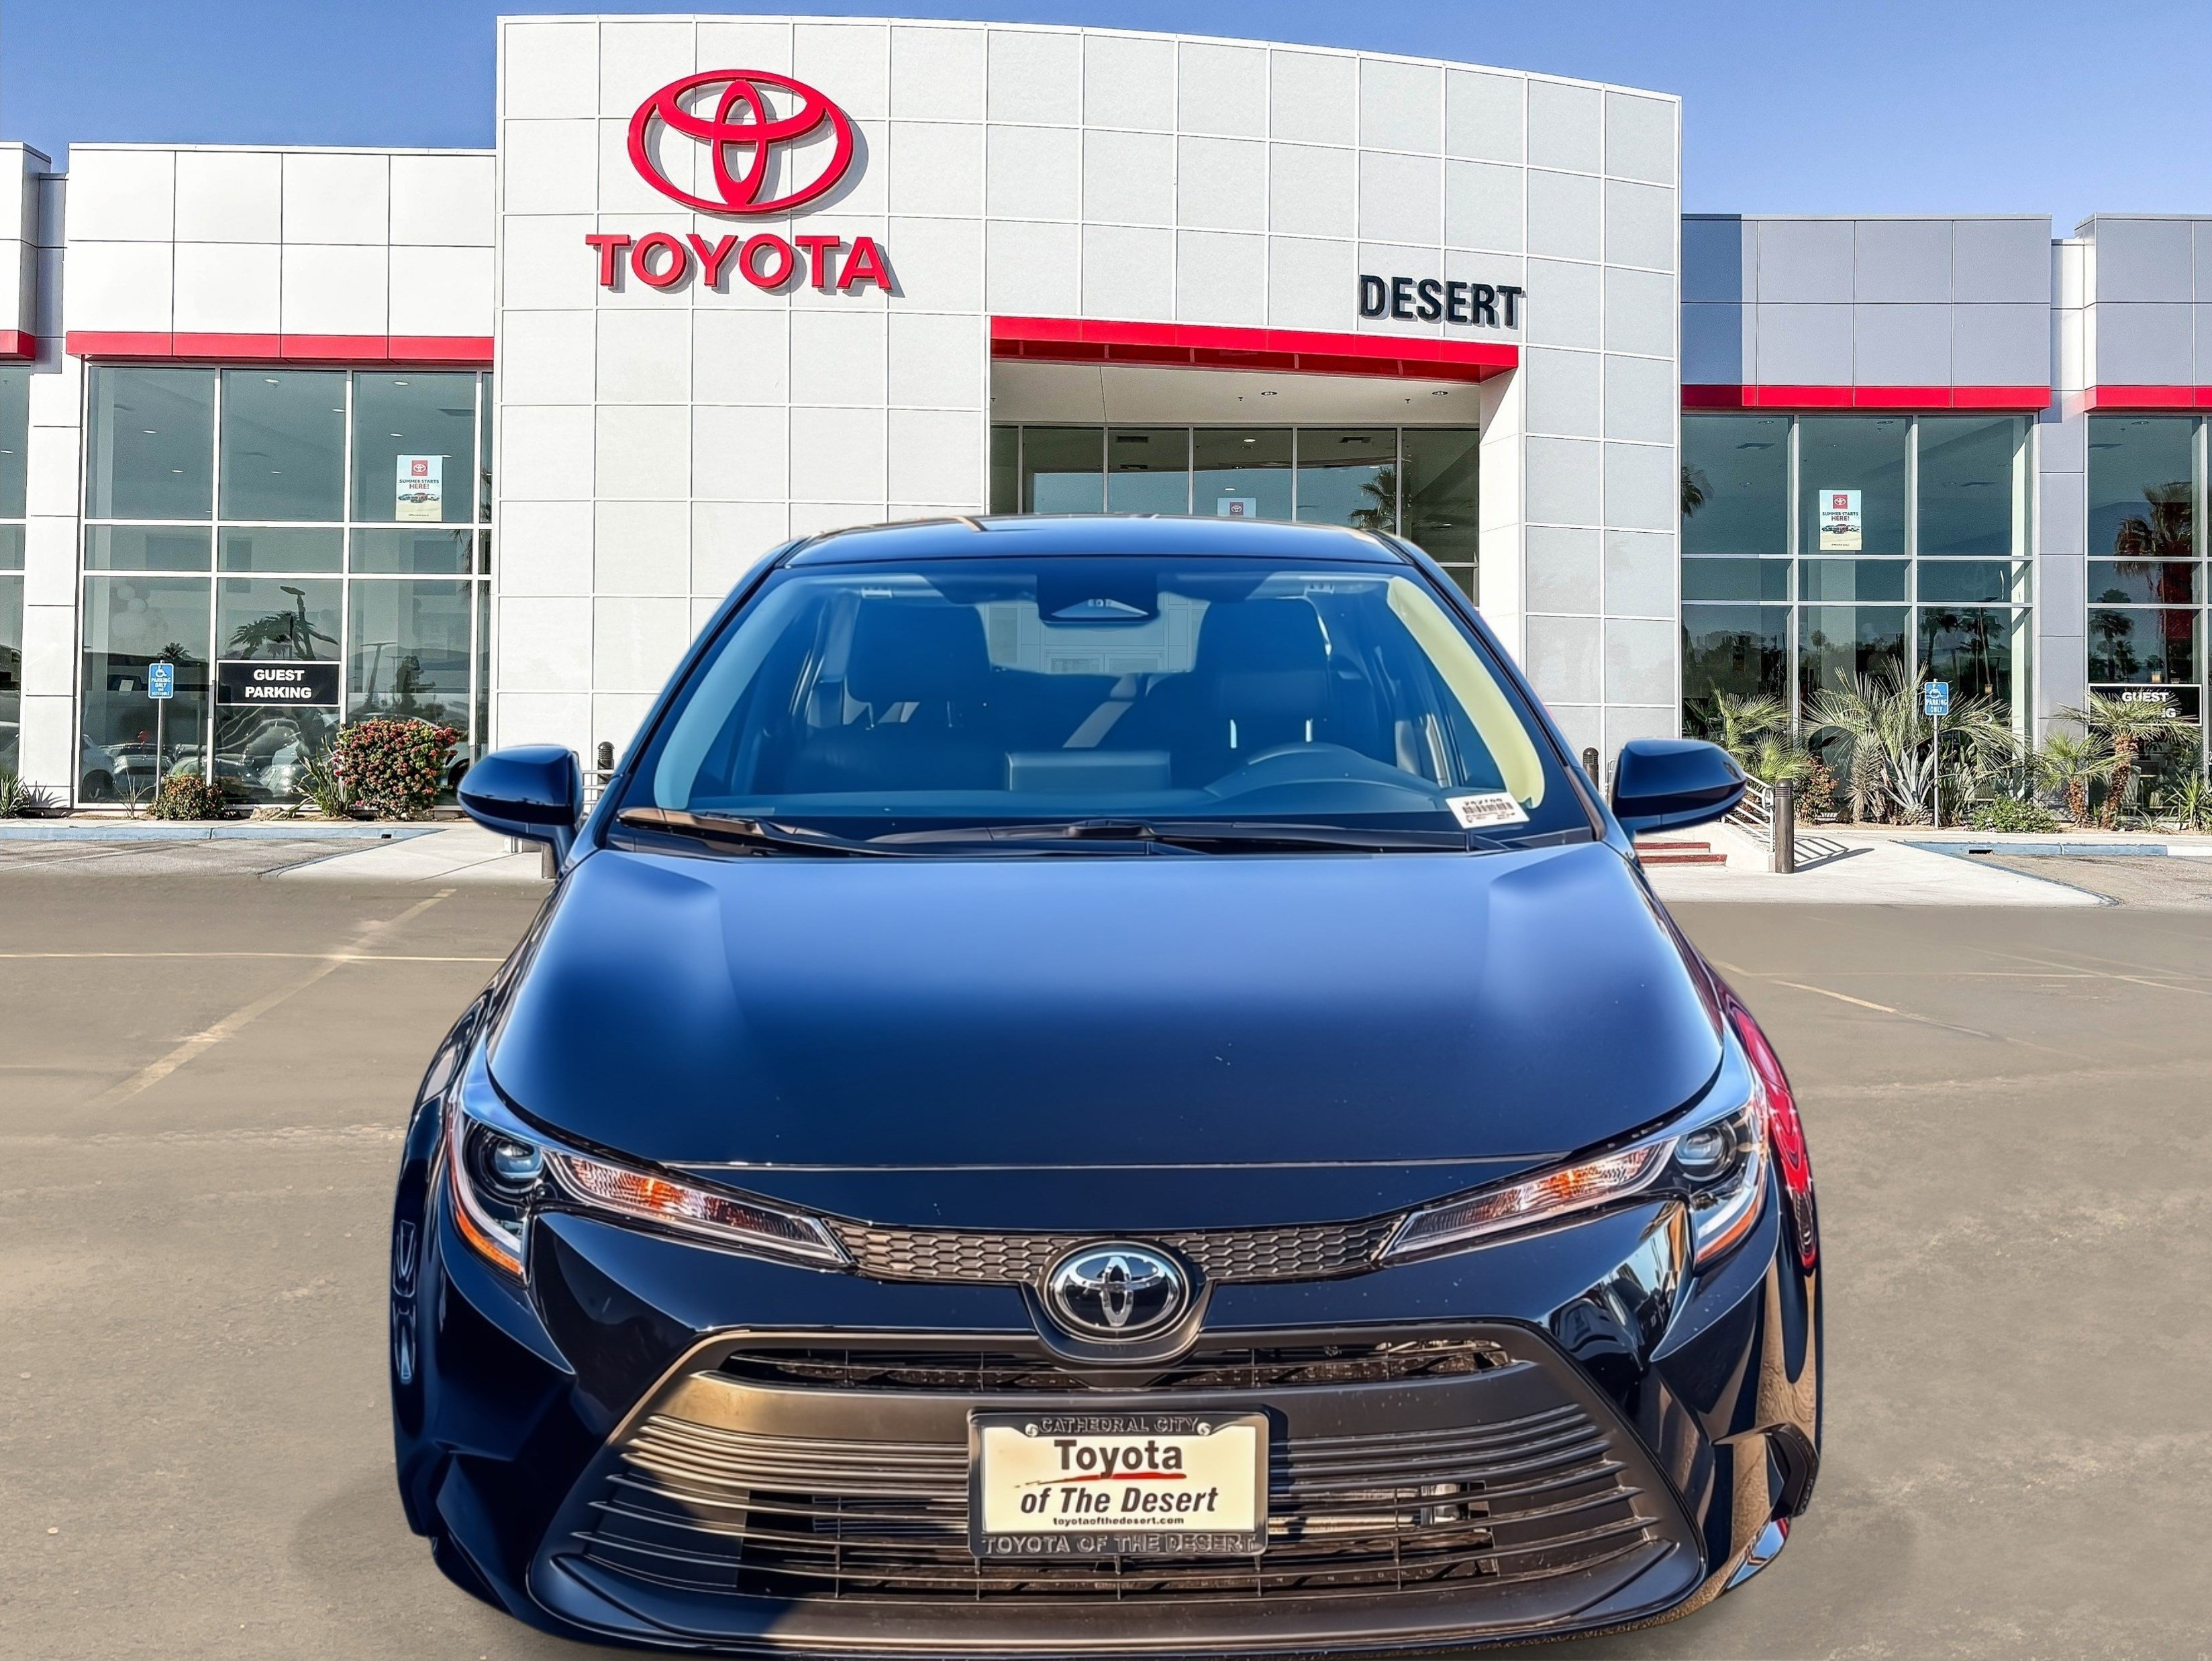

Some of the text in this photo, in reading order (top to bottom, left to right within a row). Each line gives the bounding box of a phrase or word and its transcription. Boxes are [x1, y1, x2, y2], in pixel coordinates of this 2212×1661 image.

[585, 232, 893, 289] TOYOTA
[1359, 274, 1522, 327] DESERT
[253, 669, 305, 681] GUEST
[245, 687, 312, 699] PARKING
[2121, 691, 2169, 703] GUEST
[1040, 1417, 1199, 1433] CATHEDRAL CITY
[1054, 1440, 1183, 1479] Toyota
[1020, 1487, 1219, 1513] of The Desert
[1053, 1517, 1185, 1527] toyotaofthedesert.com
[982, 1533, 1256, 1555] TOYOTA OF THE DESERT
